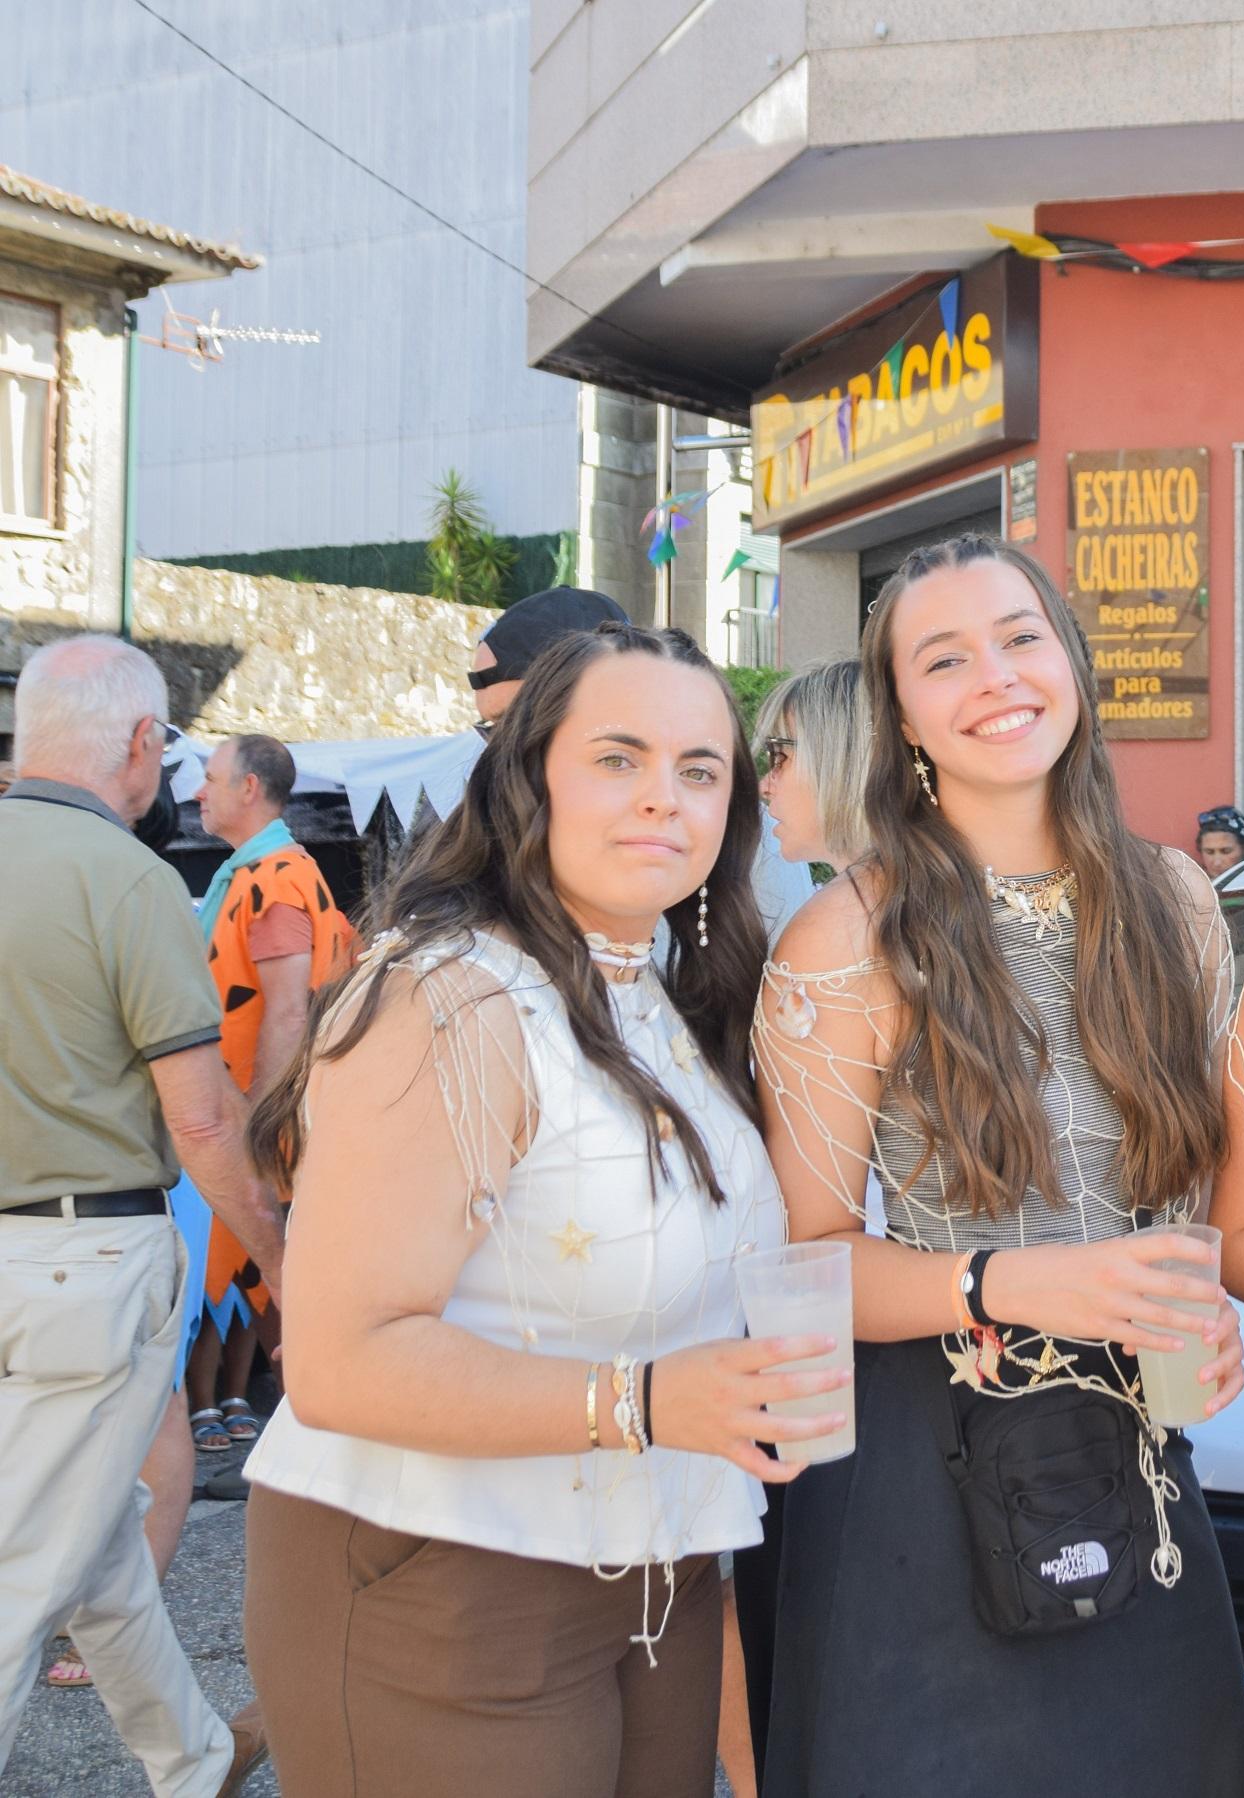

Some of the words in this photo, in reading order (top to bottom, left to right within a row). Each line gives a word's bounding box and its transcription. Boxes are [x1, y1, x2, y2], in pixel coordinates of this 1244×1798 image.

[803, 313, 992, 469] TABACOS
[1076, 466, 1198, 527] ESTANCO
[1076, 531, 1198, 592] CACHEIRAS
[1098, 602, 1177, 629] Regalos
[1114, 676, 1161, 698] para
[1097, 697, 1193, 719] umadores
[1060, 1542, 1086, 1559] THE
[1040, 1553, 1086, 1577] NORTH
[1055, 1567, 1088, 1585] FACE
